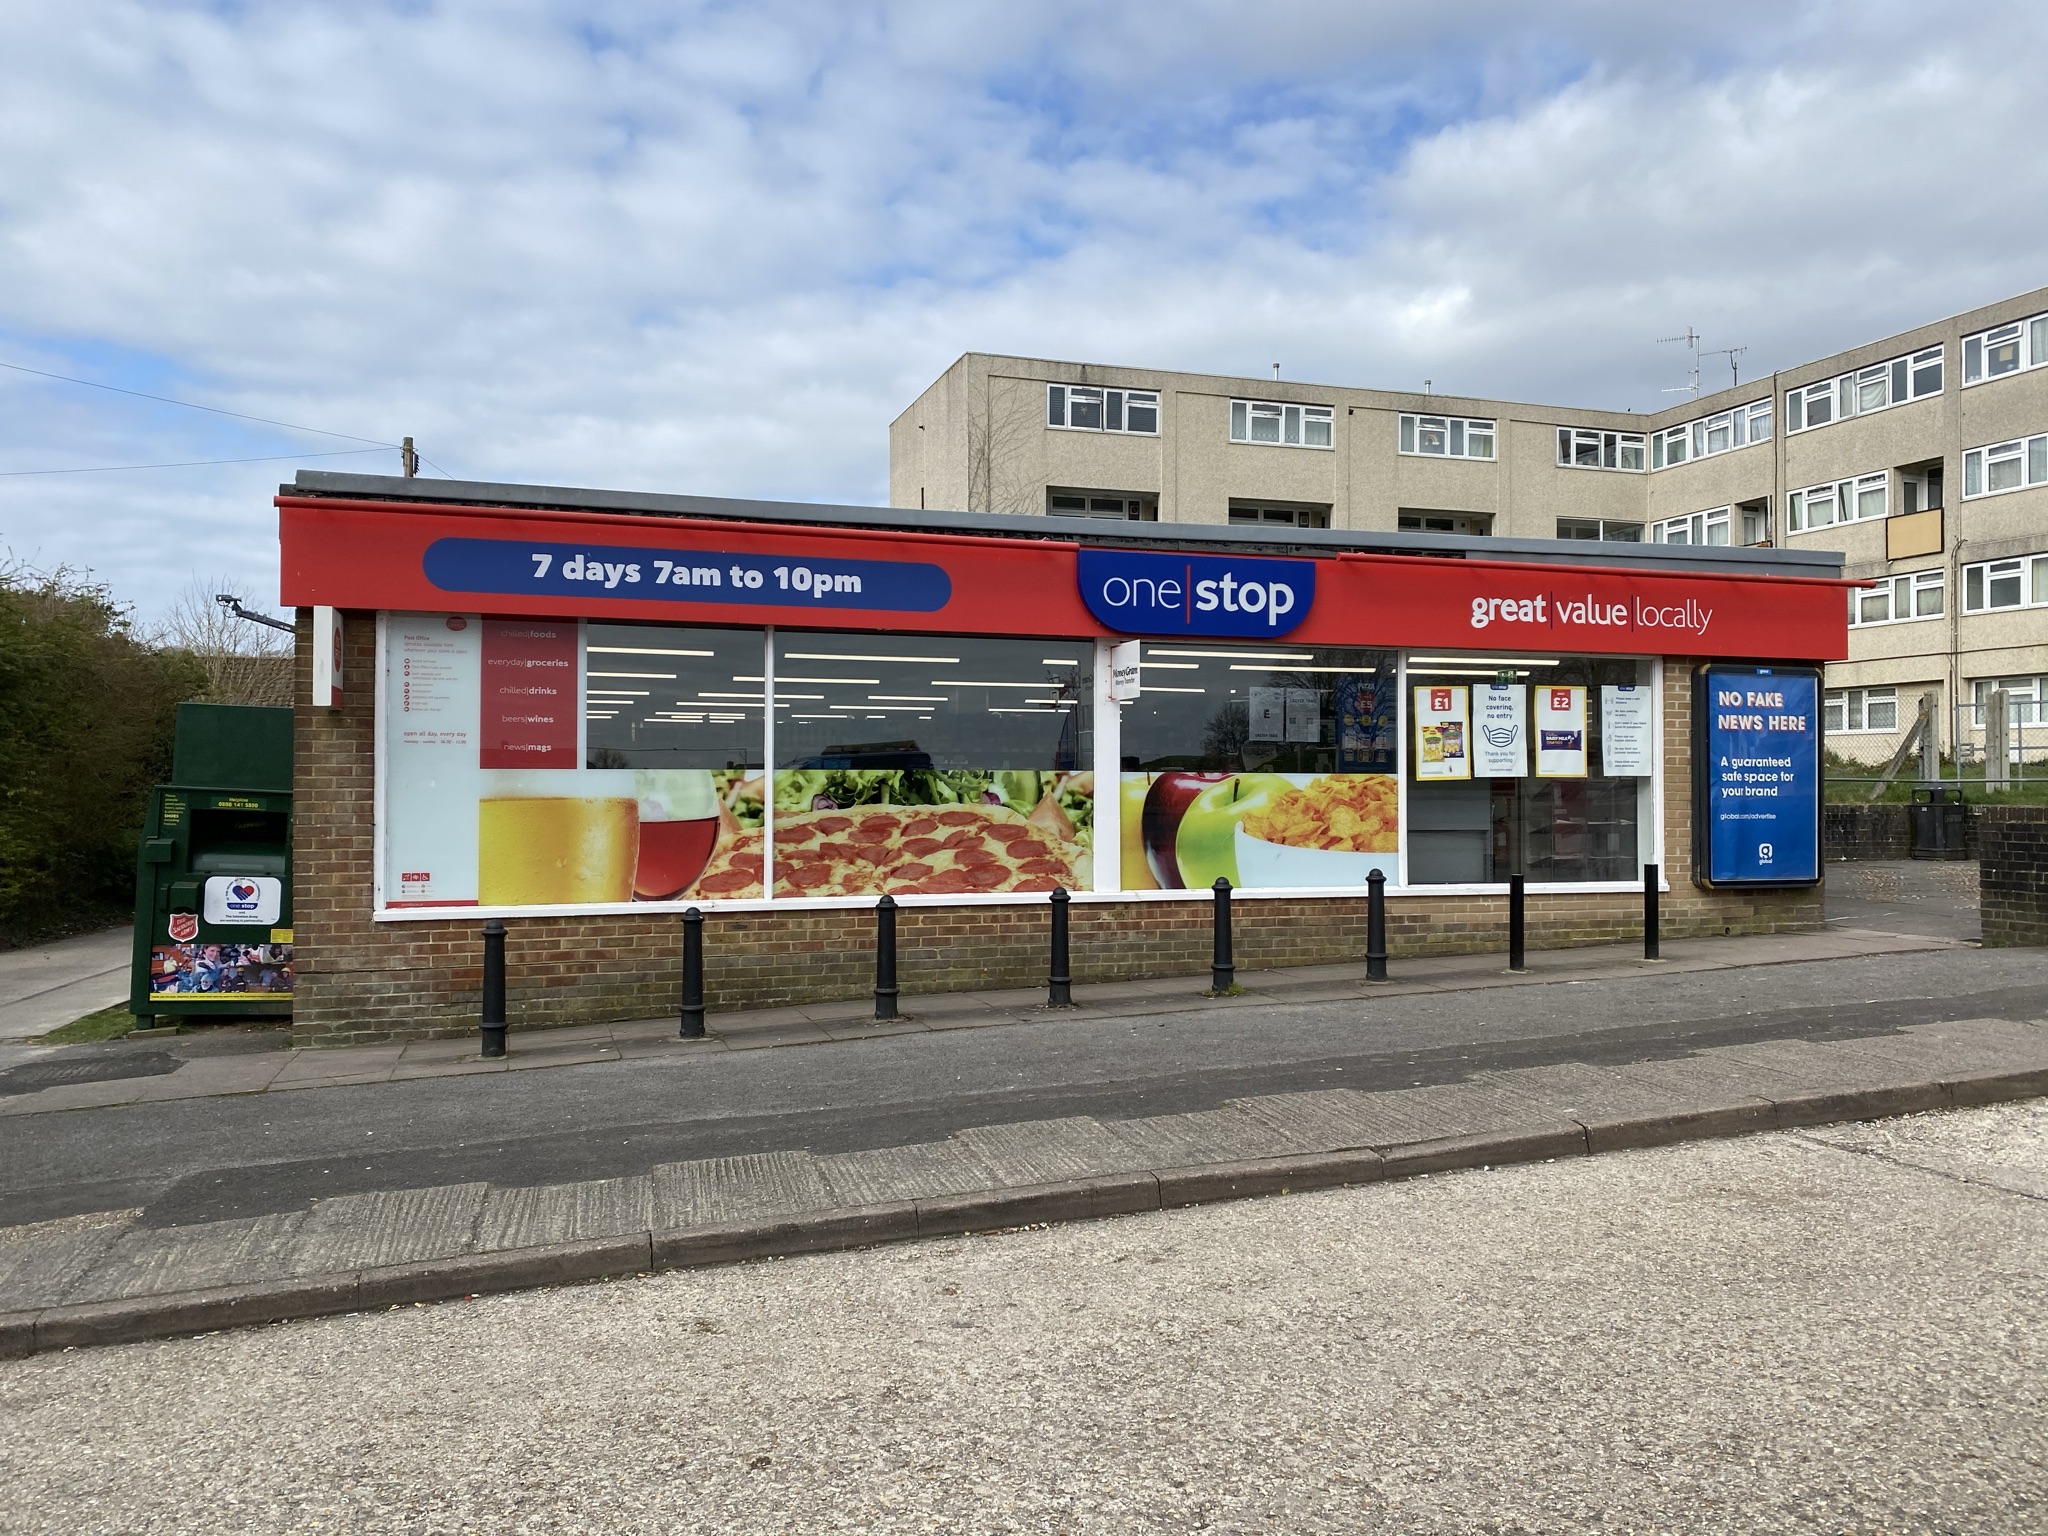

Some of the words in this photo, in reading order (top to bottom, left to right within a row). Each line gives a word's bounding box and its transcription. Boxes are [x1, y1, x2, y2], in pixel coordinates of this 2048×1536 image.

[531, 553, 553, 578] 7
[562, 554, 641, 589] days
[653, 560, 722, 586] 7am
[729, 565, 764, 589] to
[773, 566, 862, 599] 10pm
[1103, 576, 1182, 609] one
[1195, 572, 1295, 626] stop
[1470, 594, 1547, 629] great
[1556, 594, 1628, 626] value
[1636, 596, 1713, 636] locally
[530, 630, 557, 638] foods
[488, 658, 524, 667] everyday
[526, 658, 569, 668] groceries
[499, 686, 527, 694] chilled
[528, 686, 557, 695] drinks
[1434, 697, 1449, 710] £1
[1553, 697, 1569, 708] £2
[1718, 691, 1743, 707] NO
[1746, 691, 1784, 707] FAKE
[502, 715, 525, 723] beers
[527, 714, 554, 723] wines
[1264, 709, 1271, 719] E
[1718, 714, 1764, 730] NEWS
[1768, 715, 1806, 731] HERE
[528, 744, 552, 753] mags
[1720, 756, 1729, 767] A
[1731, 756, 1791, 769] guaranteed
[1722, 771, 1742, 782] safe
[1744, 773, 1778, 784] space
[1780, 771, 1794, 782] for
[1721, 787, 1744, 798] your
[1745, 785, 1778, 796] brand
